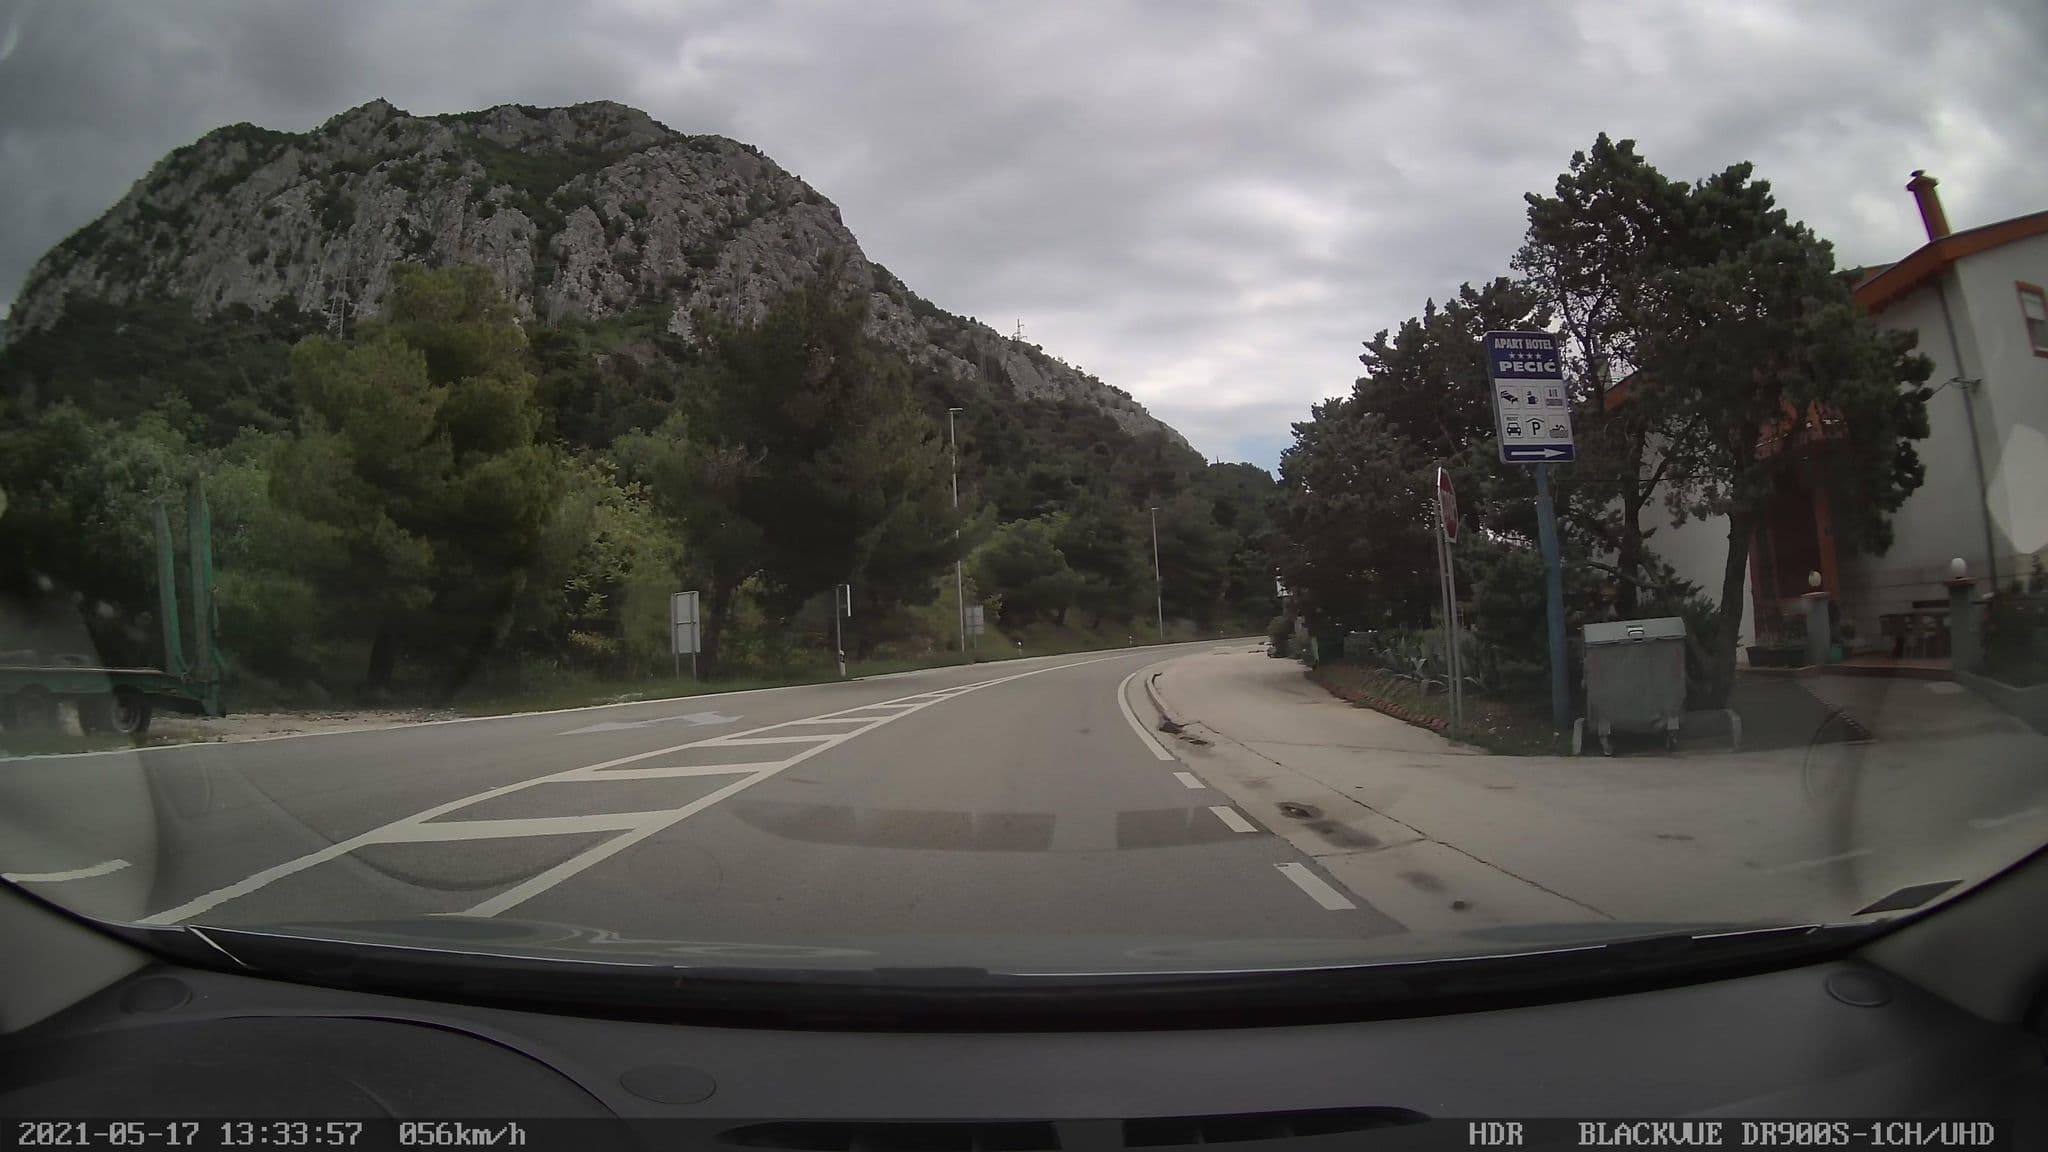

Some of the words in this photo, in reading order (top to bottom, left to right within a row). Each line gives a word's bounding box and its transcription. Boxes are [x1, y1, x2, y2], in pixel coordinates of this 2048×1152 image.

[1495, 338, 1523, 349] APART
[1525, 339, 1553, 350] HOTEL
[1532, 421, 1541, 436] P
